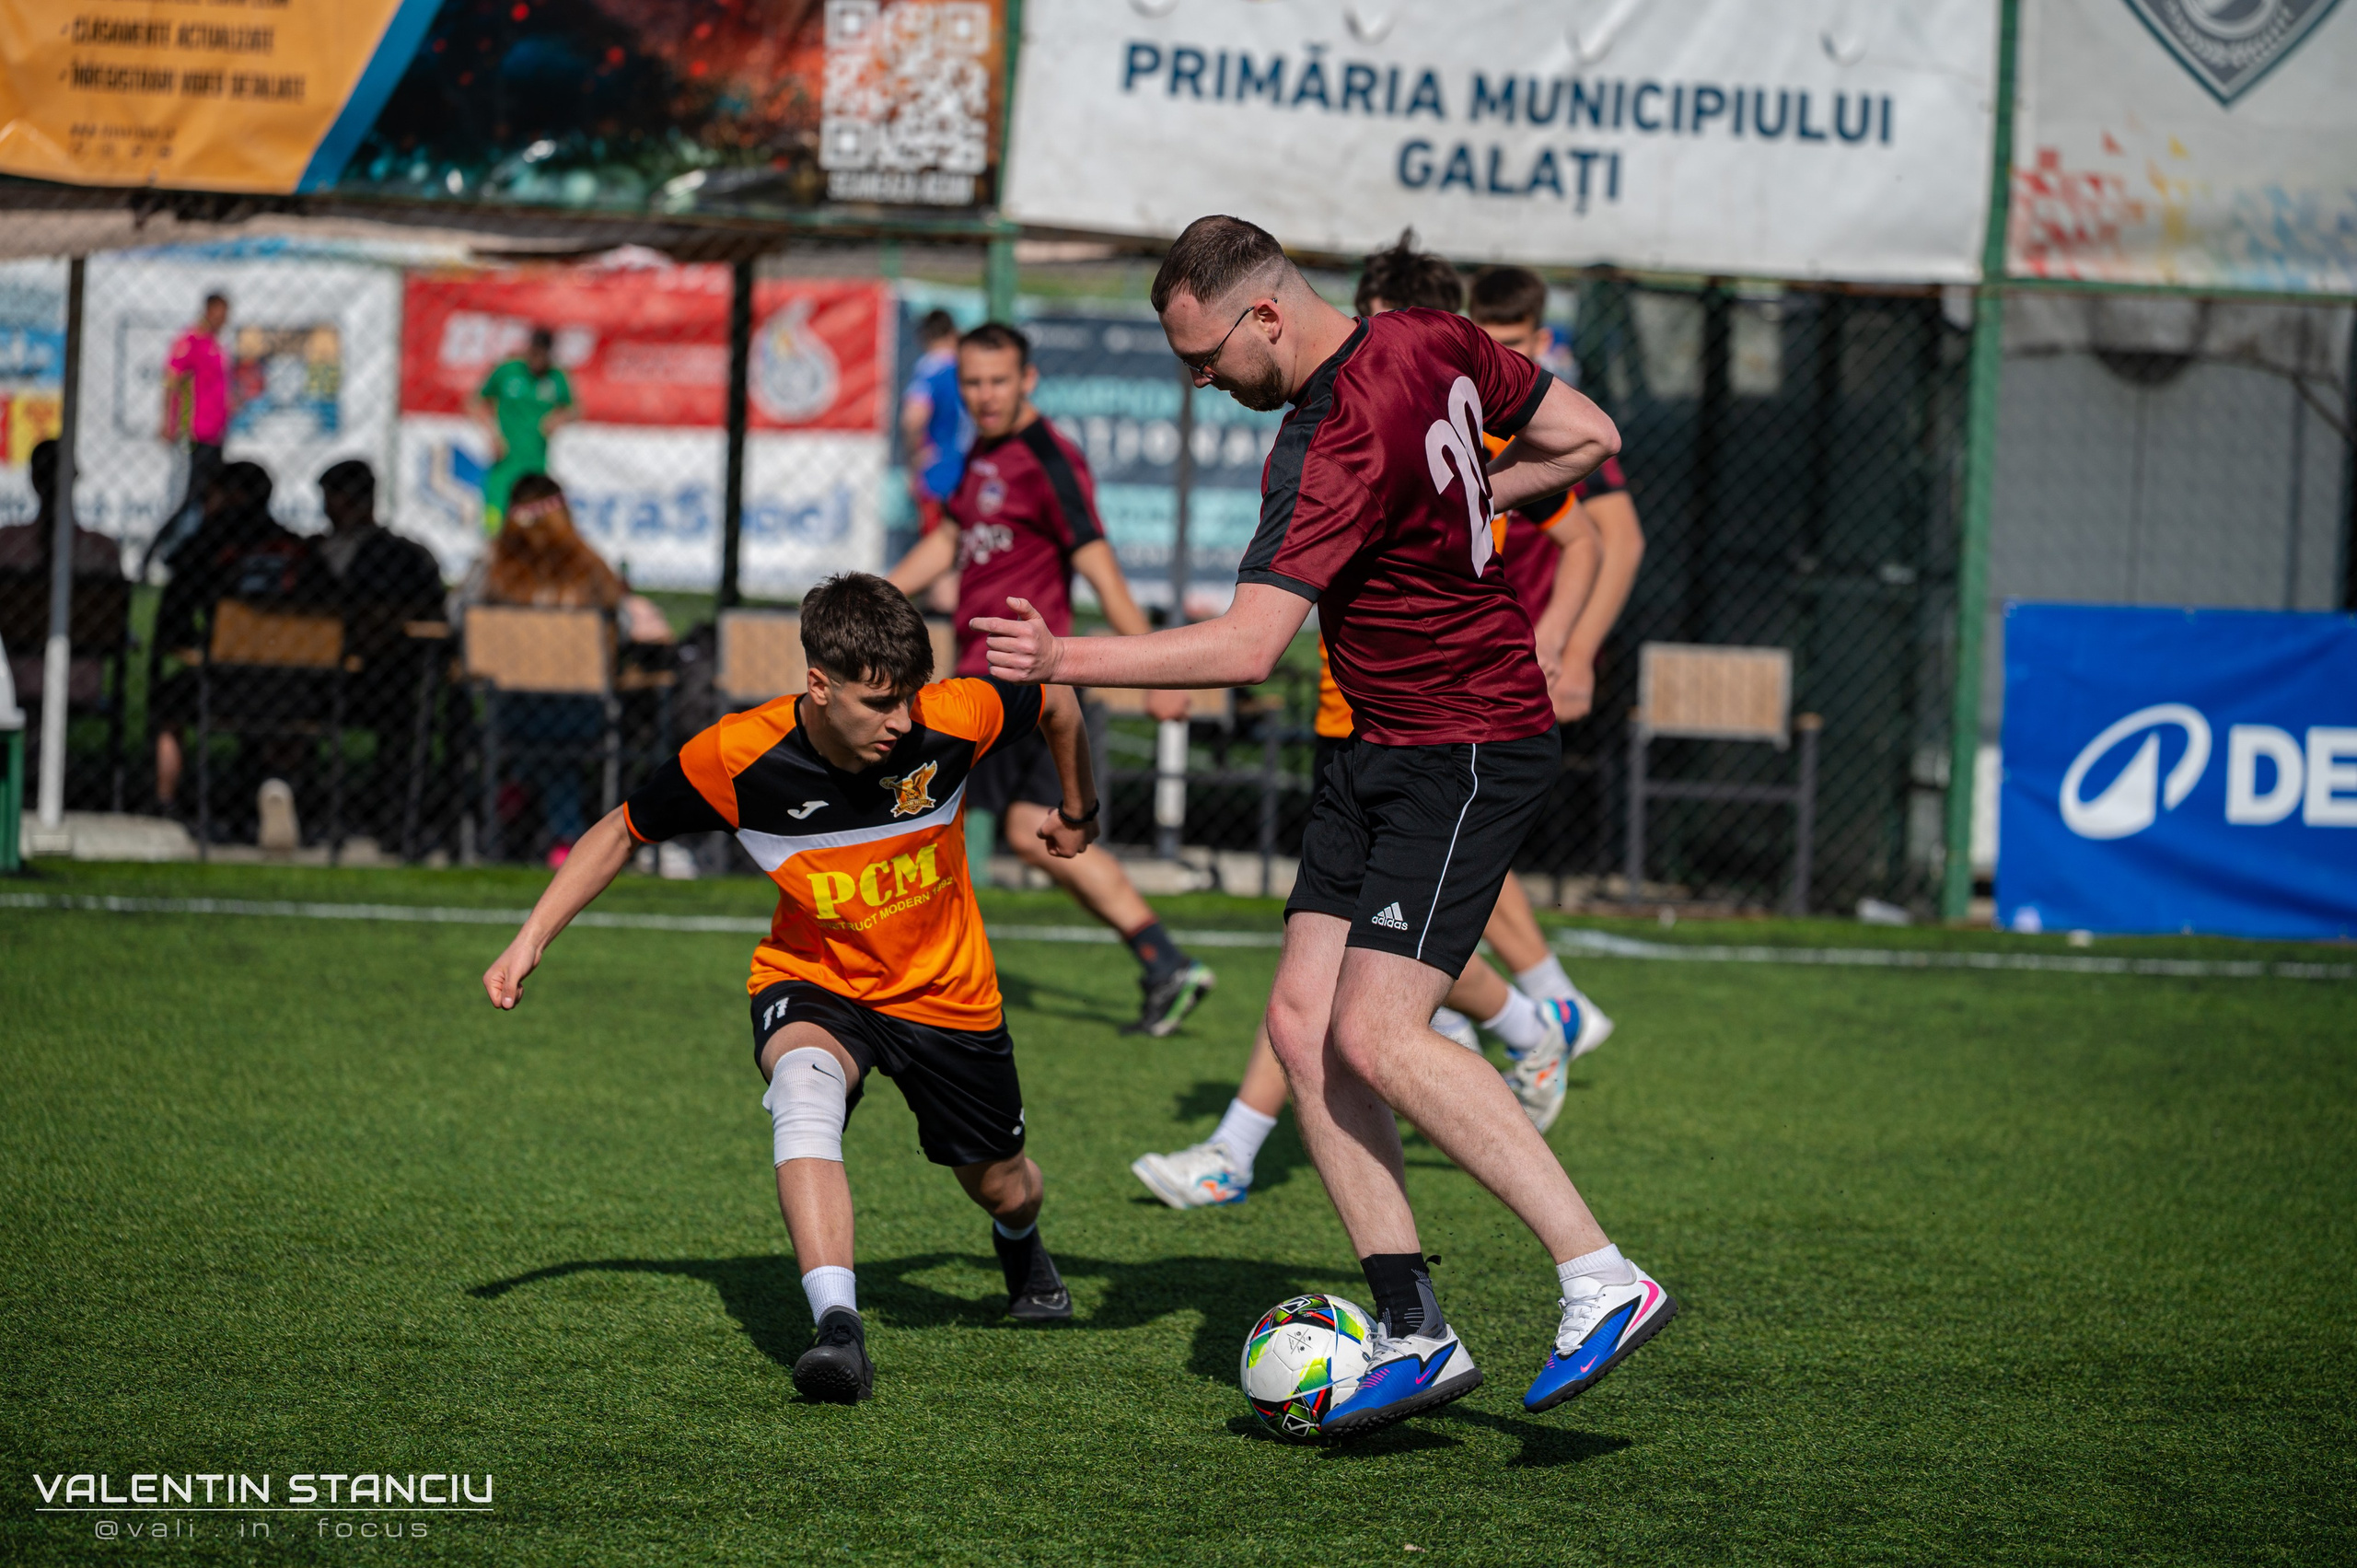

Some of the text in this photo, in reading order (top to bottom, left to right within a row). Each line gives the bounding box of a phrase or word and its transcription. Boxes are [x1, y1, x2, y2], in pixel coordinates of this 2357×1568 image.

[1124, 42, 1893, 145] PRIMĂRIA MUNICIPIULUI
[1398, 138, 1621, 215] GALAȚI
[1425, 376, 1494, 578] 20
[2225, 723, 2357, 828] DE
[807, 842, 940, 920] PCM
[879, 893, 930, 920] MODERN
[1371, 915, 1409, 931] adidas
[762, 997, 790, 1030] 11
